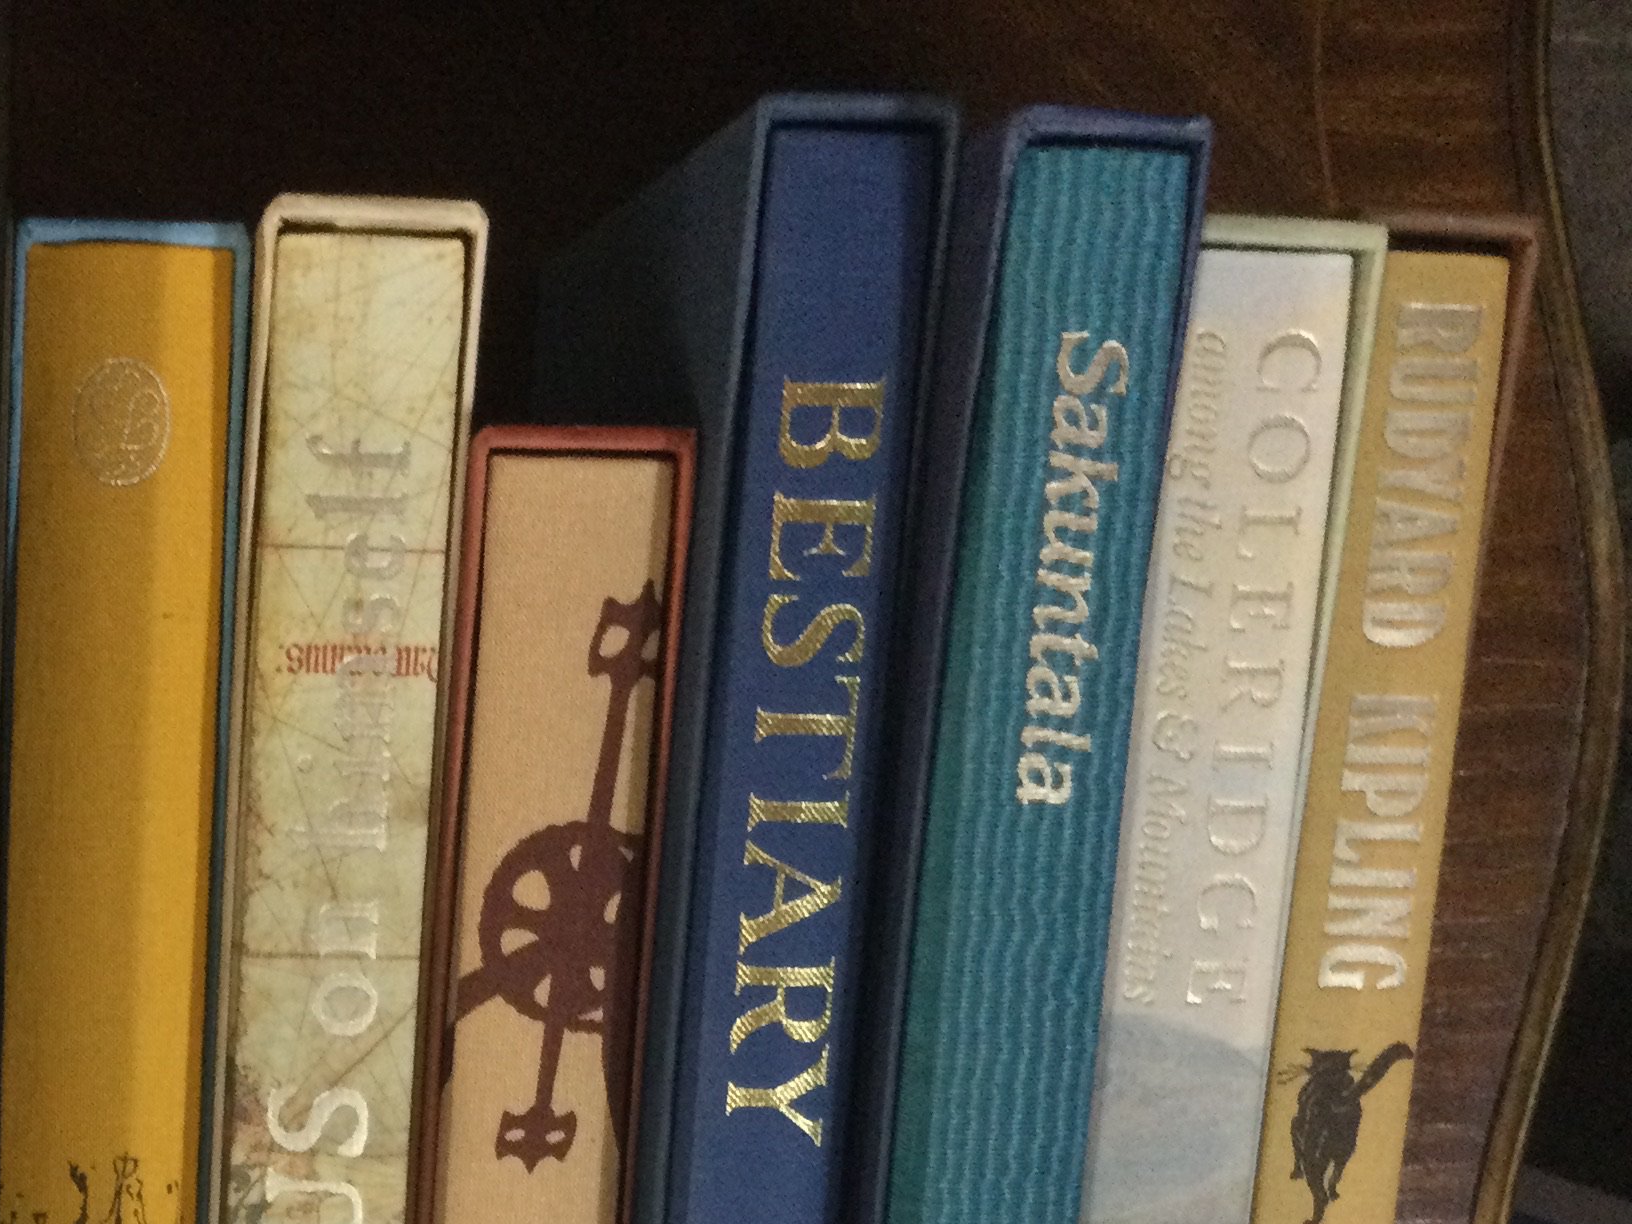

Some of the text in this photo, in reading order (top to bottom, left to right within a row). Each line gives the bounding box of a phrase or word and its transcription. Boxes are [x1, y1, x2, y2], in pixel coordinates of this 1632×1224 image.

[1168, 330, 1226, 489] among
[1016, 331, 1130, 805] Sakuntala
[1173, 498, 1222, 565] the
[1156, 573, 1215, 700] Lakes
[1186, 328, 1322, 1004] COLERIDGE
[1317, 301, 1486, 991] RUDYARD KIPLING
[724, 374, 885, 1148] BESTIARY
[1151, 710, 1197, 762] &
[309, 900, 379, 1037] on
